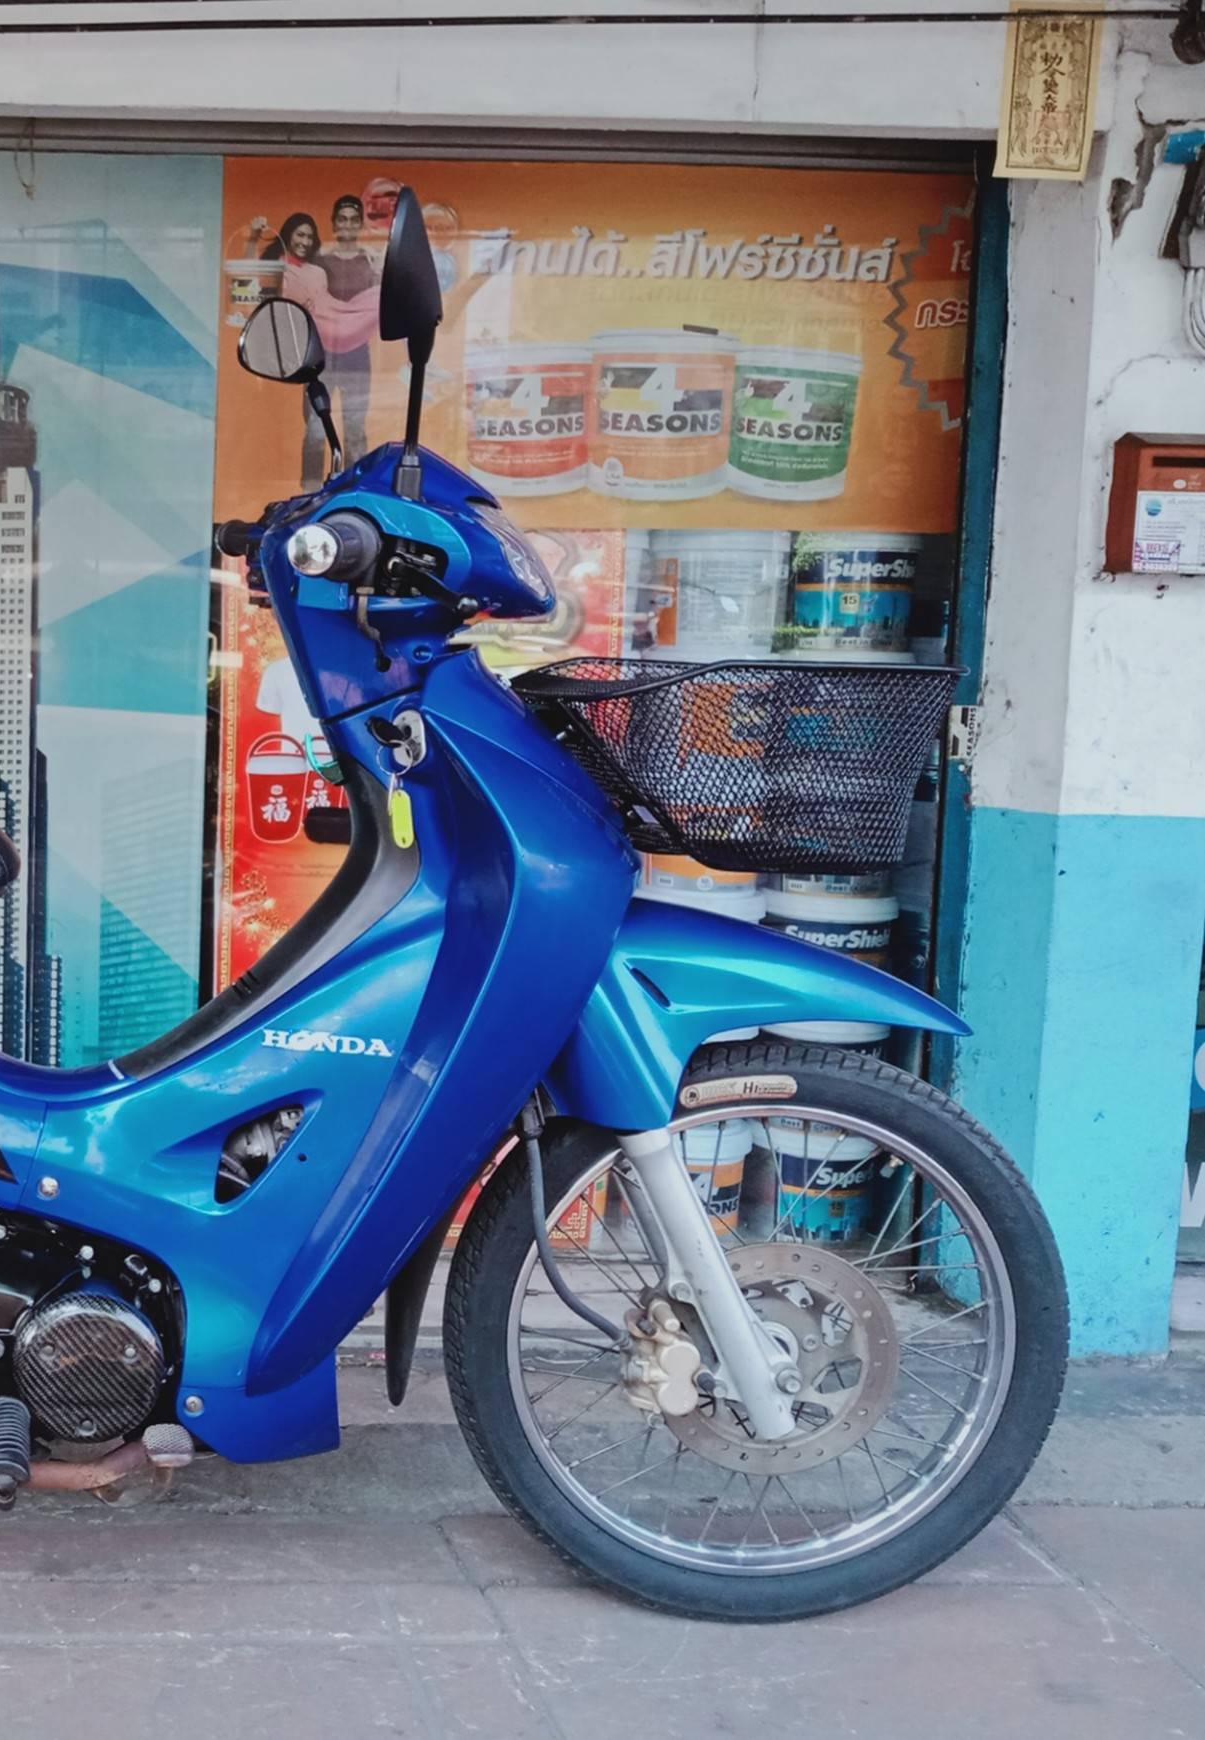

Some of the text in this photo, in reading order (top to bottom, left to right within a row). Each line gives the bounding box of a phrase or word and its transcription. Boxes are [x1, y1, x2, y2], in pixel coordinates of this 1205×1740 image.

[599, 411, 722, 433] SEASONS
[735, 417, 844, 442] SEASONS
[260, 796, 292, 823] 福
[261, 1029, 393, 1057] HONDA
